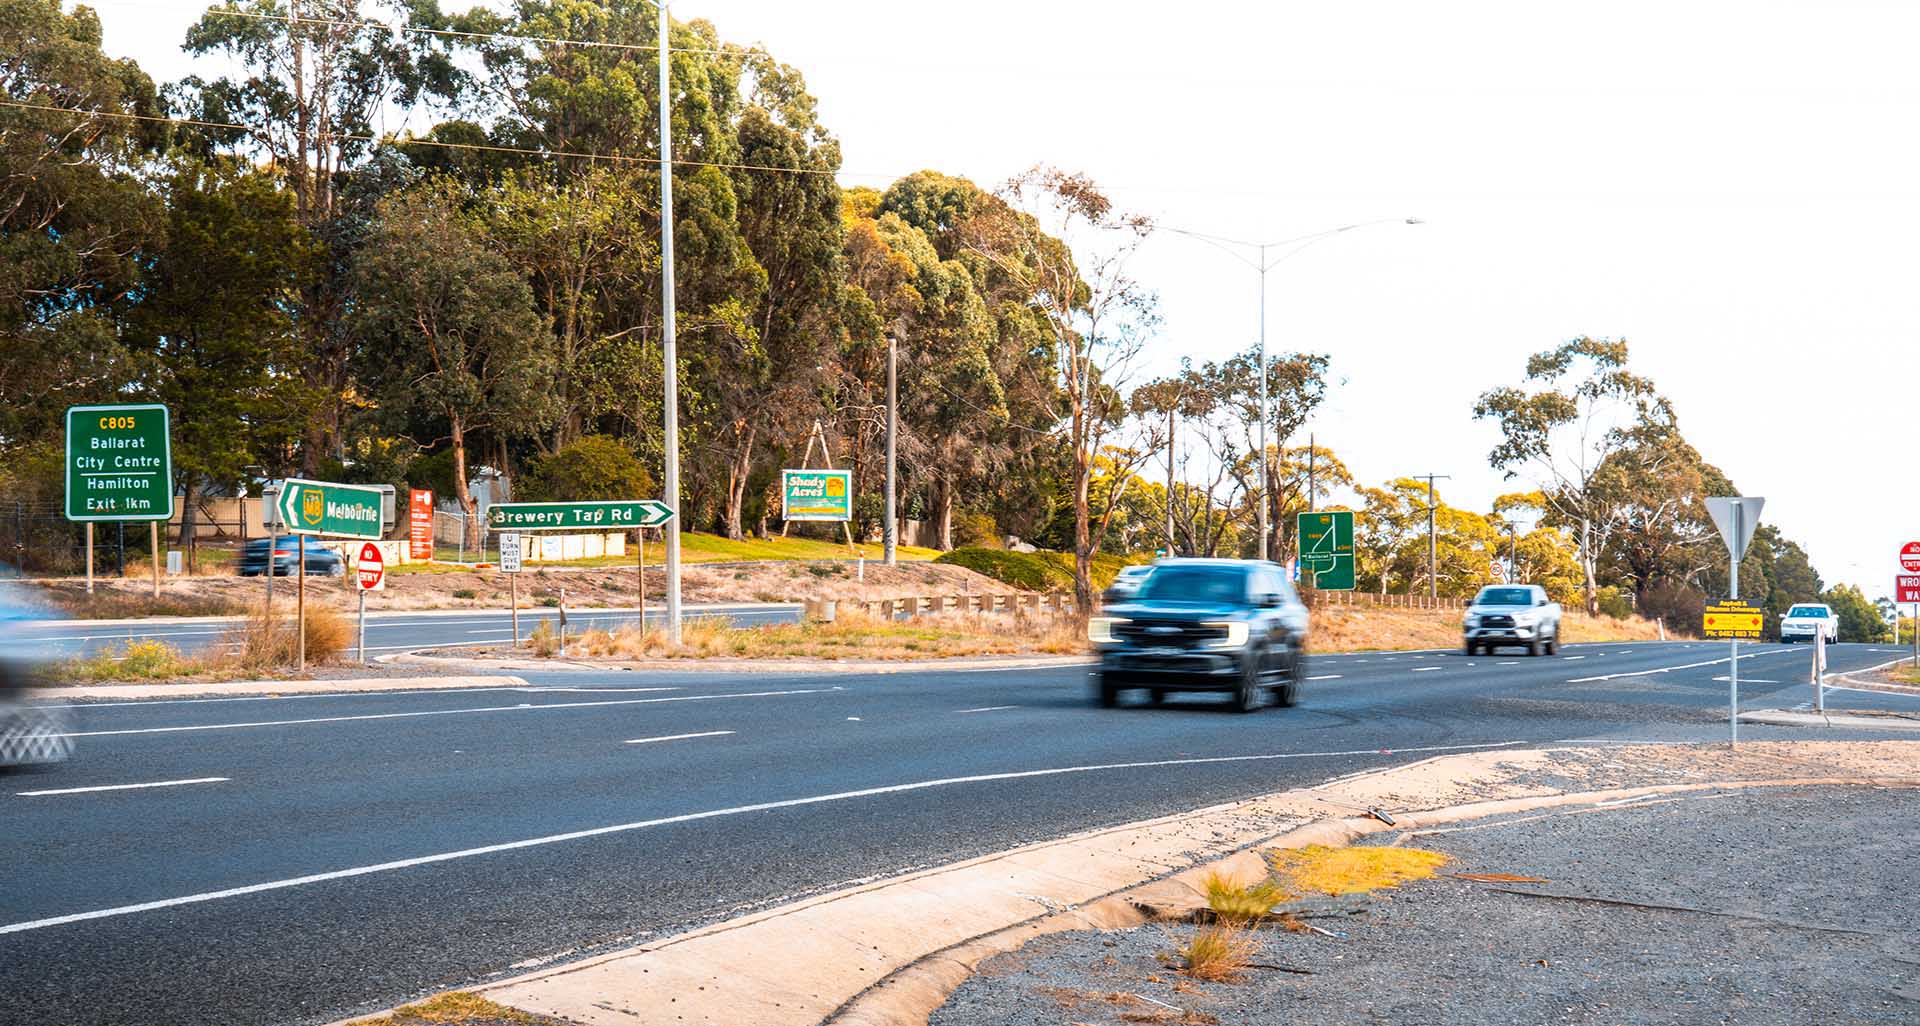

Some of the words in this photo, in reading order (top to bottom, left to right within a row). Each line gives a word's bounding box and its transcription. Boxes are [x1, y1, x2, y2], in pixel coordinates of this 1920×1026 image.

[100, 417, 135, 429] C805
[91, 437, 145, 449] Ballarat
[76, 457, 104, 470] City
[114, 456, 160, 467] Centre
[87, 478, 149, 489] Hamilton
[789, 476, 825, 489] Shady
[790, 486, 824, 496] Acres
[87, 498, 115, 509] Exit
[126, 497, 150, 509] 1km
[327, 501, 377, 522] Melbourne
[495, 511, 564, 524] Brewery
[573, 509, 603, 523] Tap
[611, 508, 632, 521] Rd
[1900, 577, 1920, 587] WRO
[1905, 591, 1920, 601] WA
